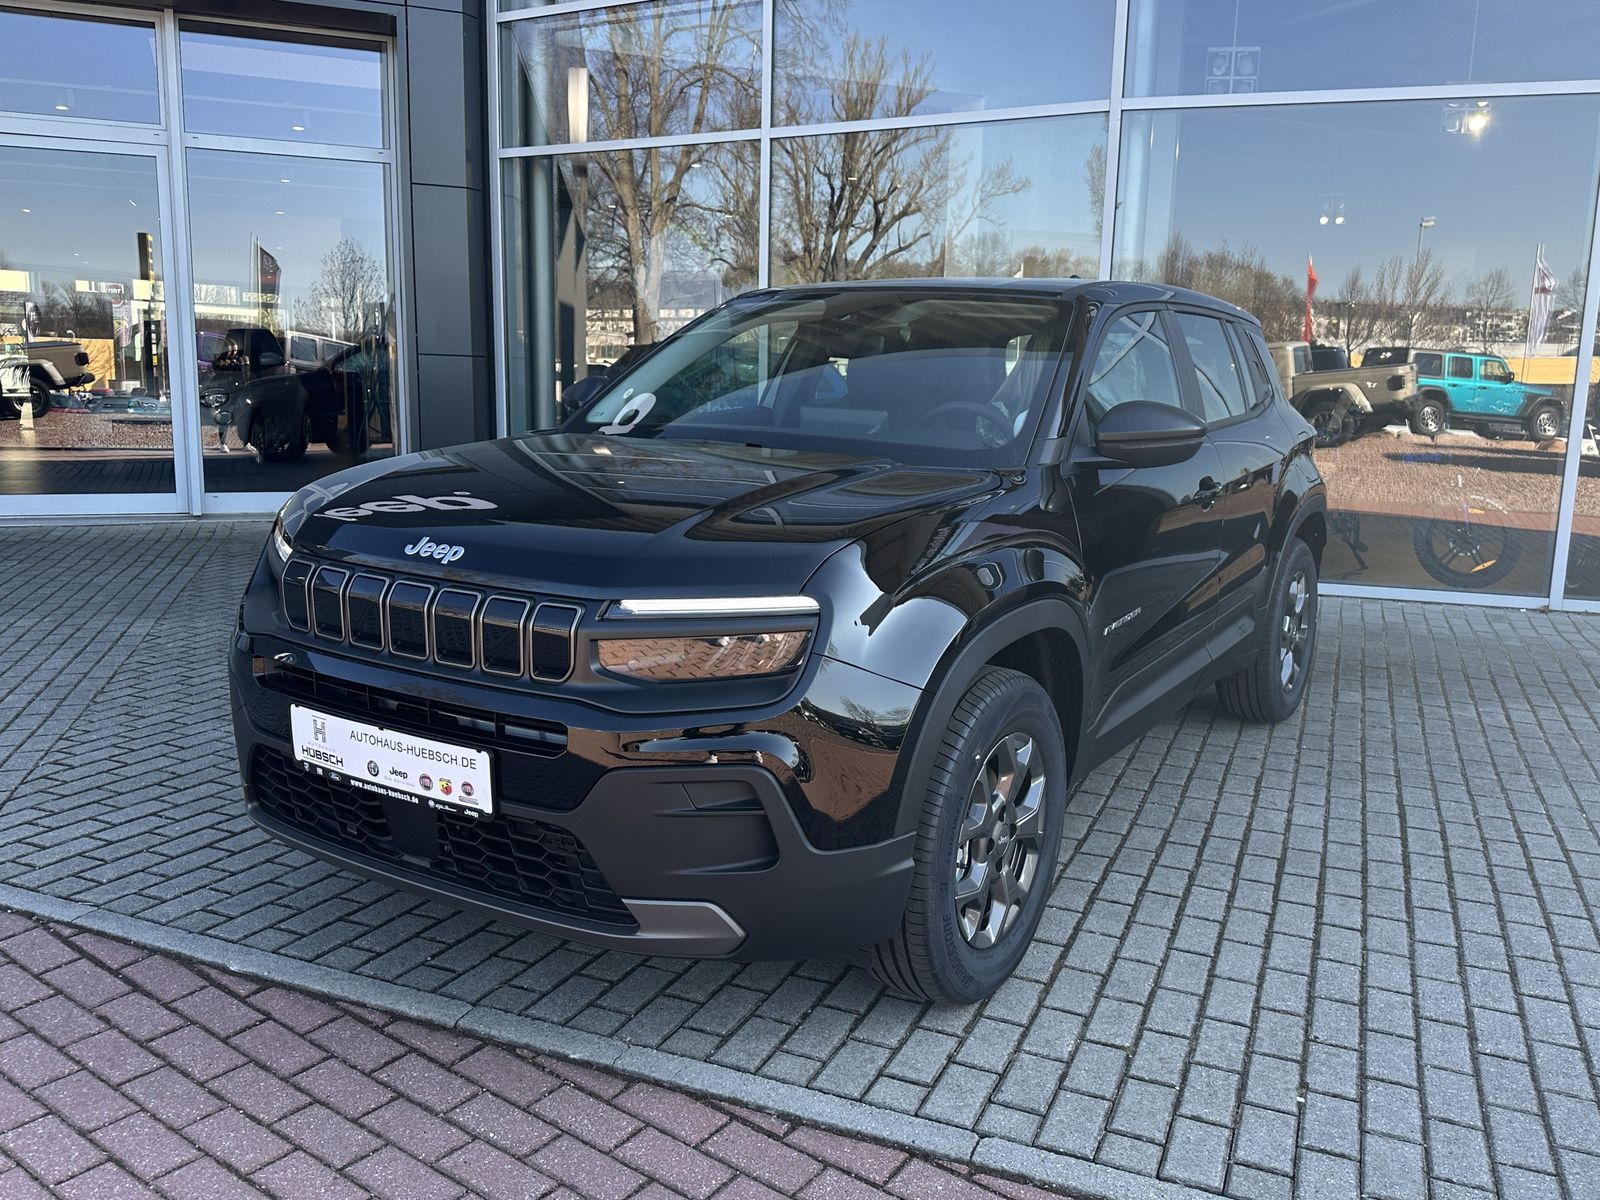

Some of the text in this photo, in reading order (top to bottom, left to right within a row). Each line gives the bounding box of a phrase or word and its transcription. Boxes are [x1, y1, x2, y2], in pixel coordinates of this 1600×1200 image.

[404, 536, 465, 565] Jeep
[349, 730, 477, 770] AUTOHAUS-HUEBSCH.DE
[389, 766, 408, 780] Jeep
